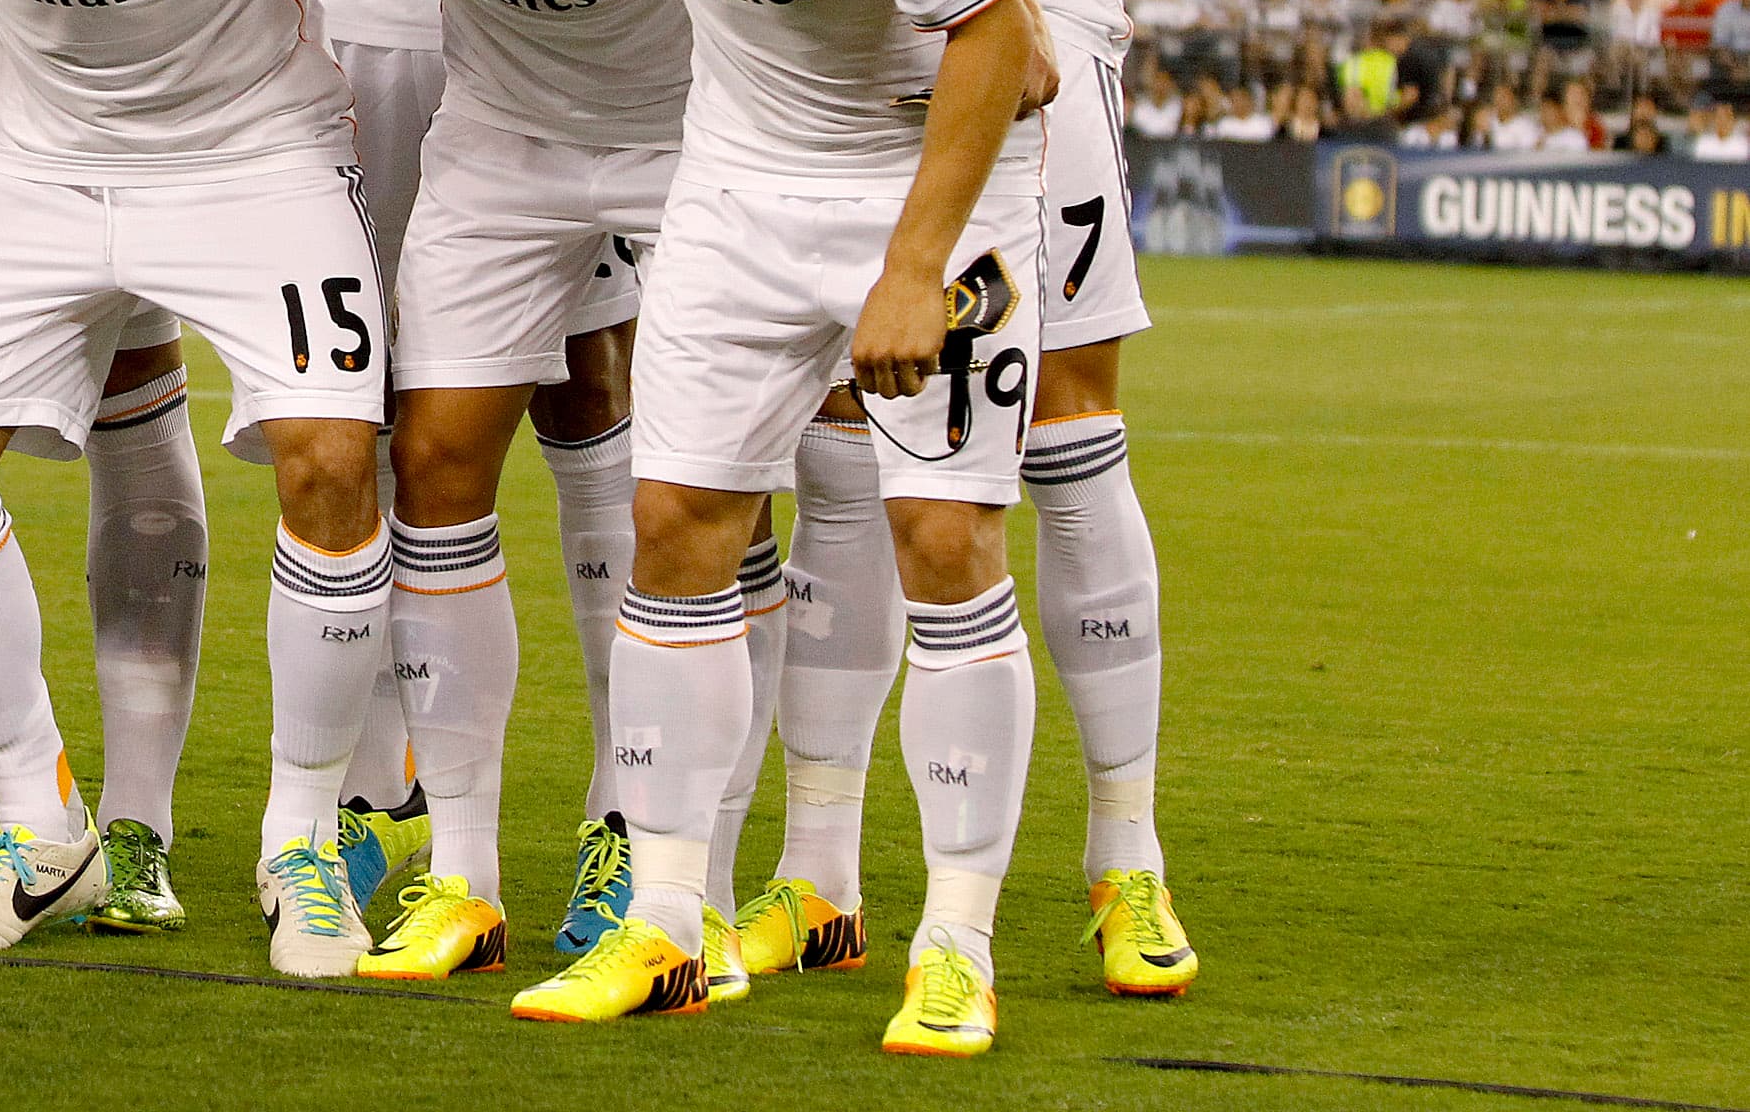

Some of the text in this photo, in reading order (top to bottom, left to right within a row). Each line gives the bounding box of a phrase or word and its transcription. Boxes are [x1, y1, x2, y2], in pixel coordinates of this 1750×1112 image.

[1421, 175, 1695, 249] GUINNESS
[1061, 195, 1105, 302] 7
[281, 277, 371, 374] 15
[947, 347, 1028, 455] 19
[576, 561, 611, 580] RM
[321, 623, 371, 642] RM
[1080, 618, 1130, 639] RM
[394, 662, 431, 680] RM
[615, 745, 653, 766] RM
[928, 760, 968, 787] RM
[36, 864, 68, 879] MARTA
